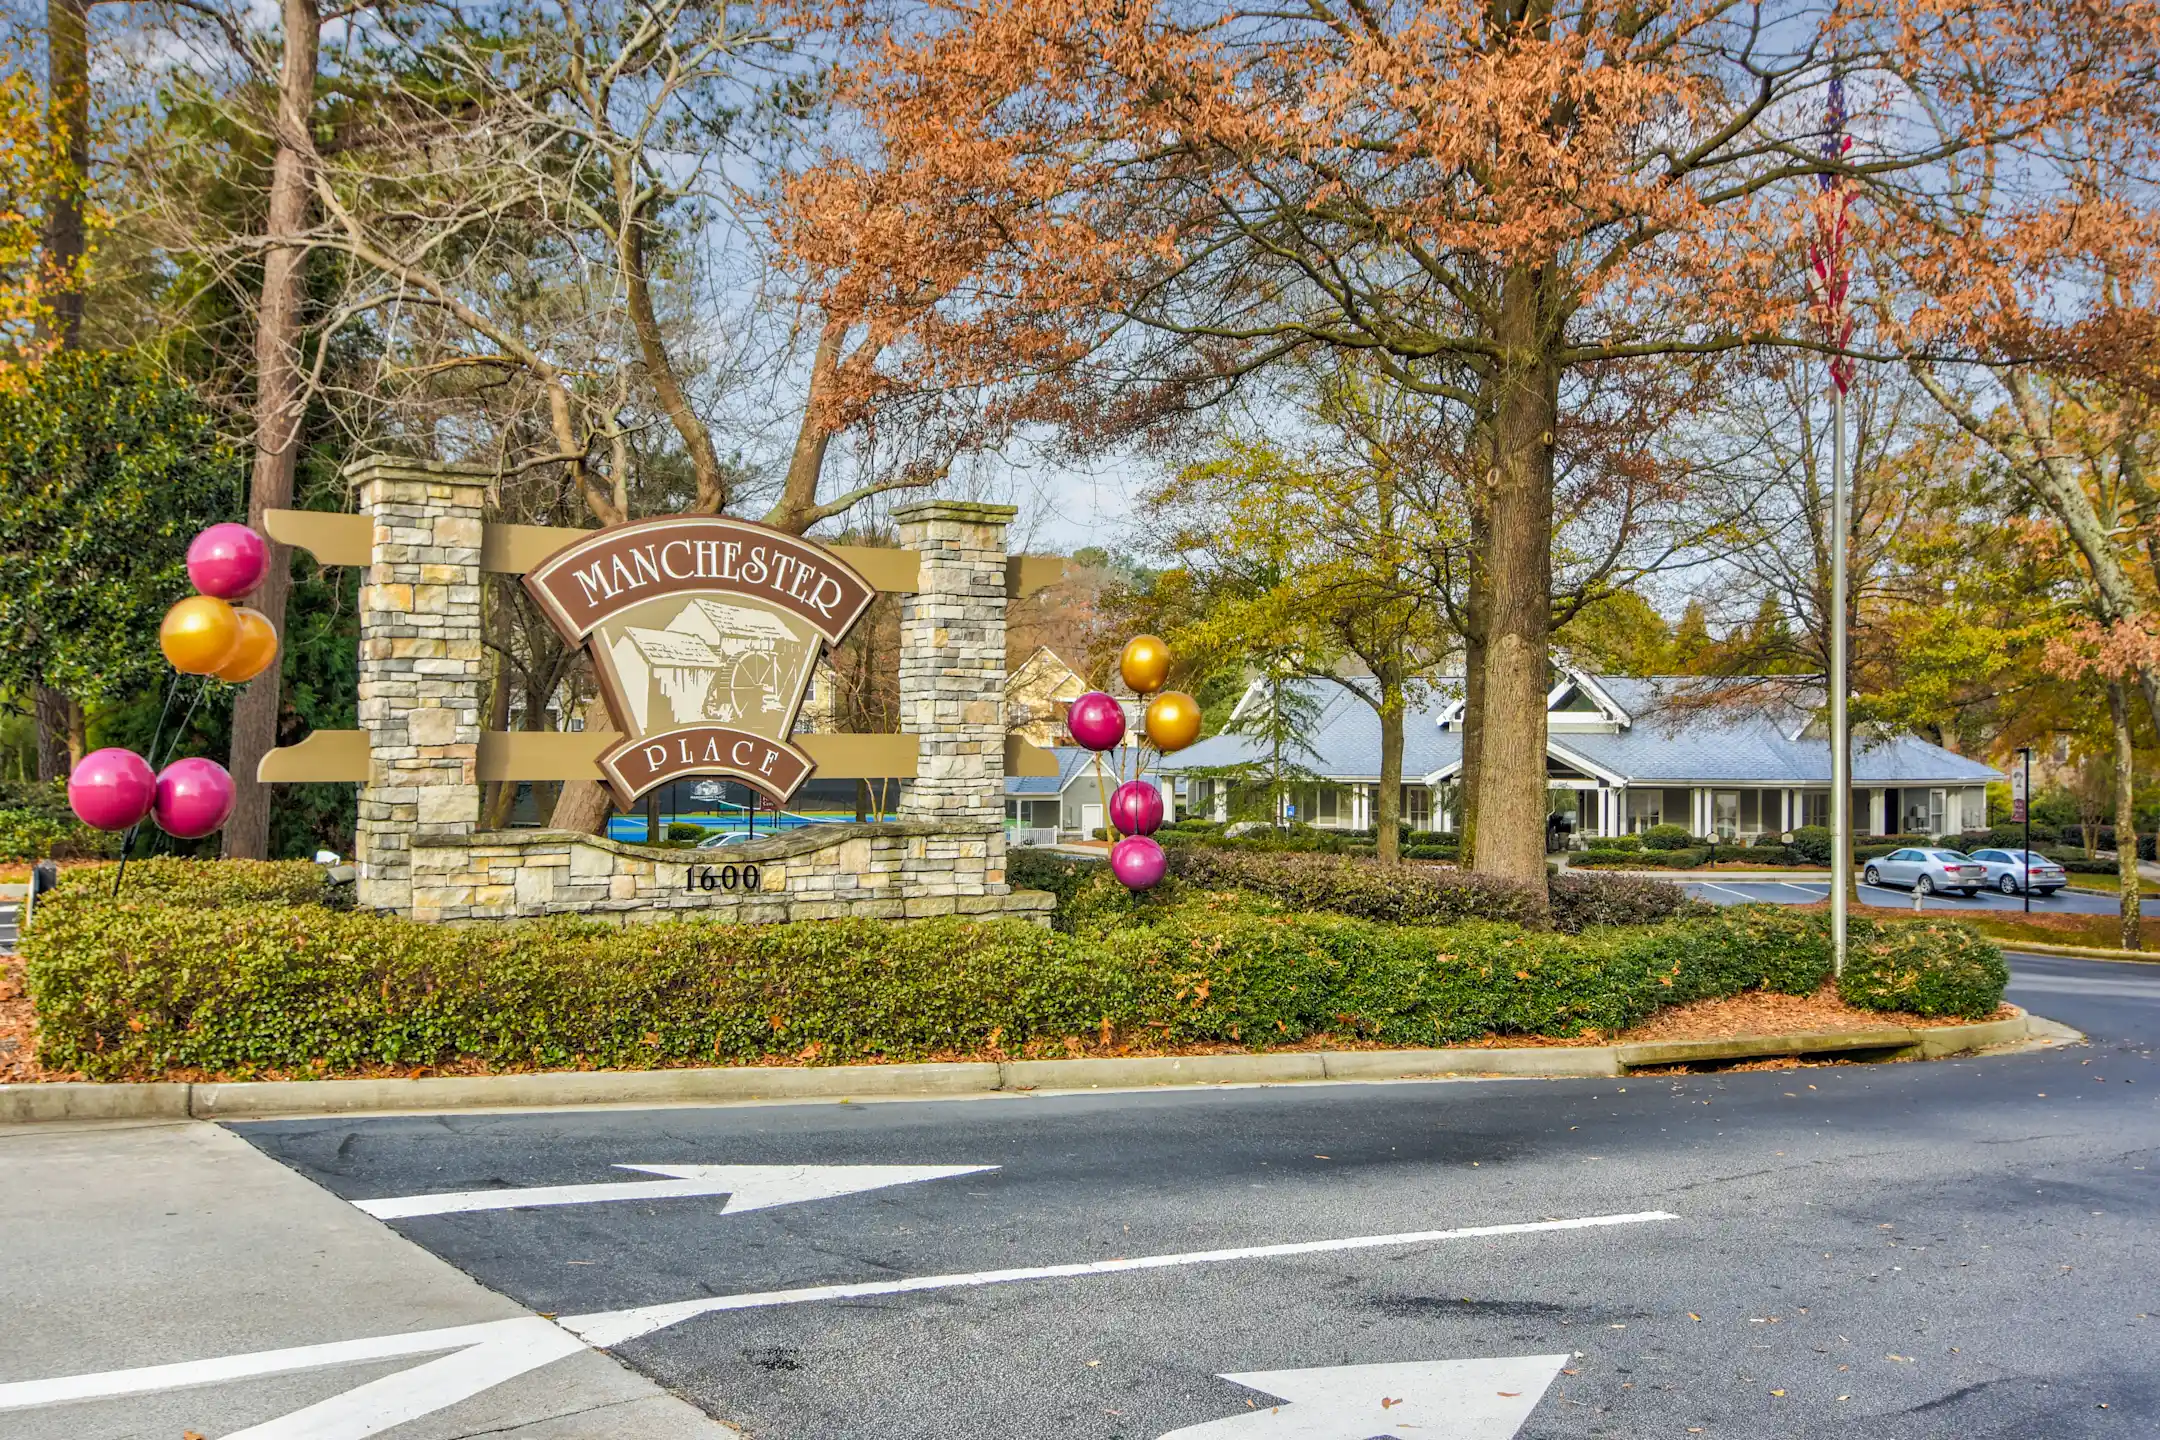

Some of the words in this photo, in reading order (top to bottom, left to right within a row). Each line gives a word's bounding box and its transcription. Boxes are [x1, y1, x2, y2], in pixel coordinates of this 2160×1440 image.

[572, 540, 842, 619] MANCHESTER
[643, 736, 779, 777] PLACE
[686, 865, 758, 891] 1600
